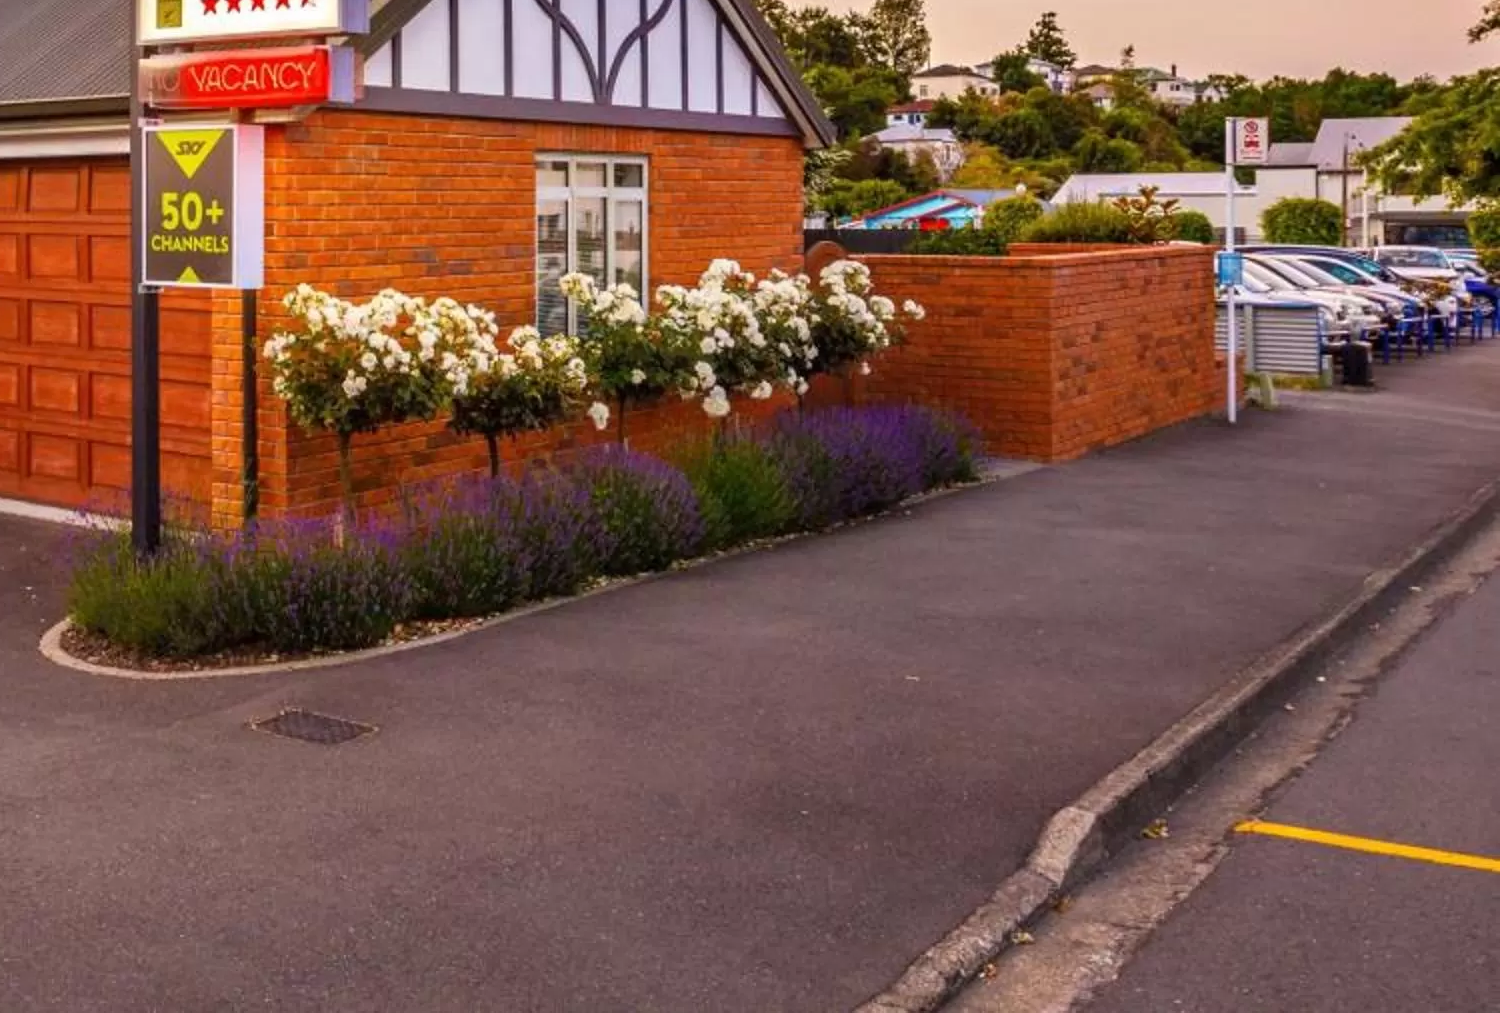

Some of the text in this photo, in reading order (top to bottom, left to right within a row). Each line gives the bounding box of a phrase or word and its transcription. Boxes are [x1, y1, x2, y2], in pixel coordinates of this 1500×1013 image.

[189, 61, 316, 92] VACANCY
[161, 190, 225, 231] 50+
[151, 234, 229, 254] CHANNELS
